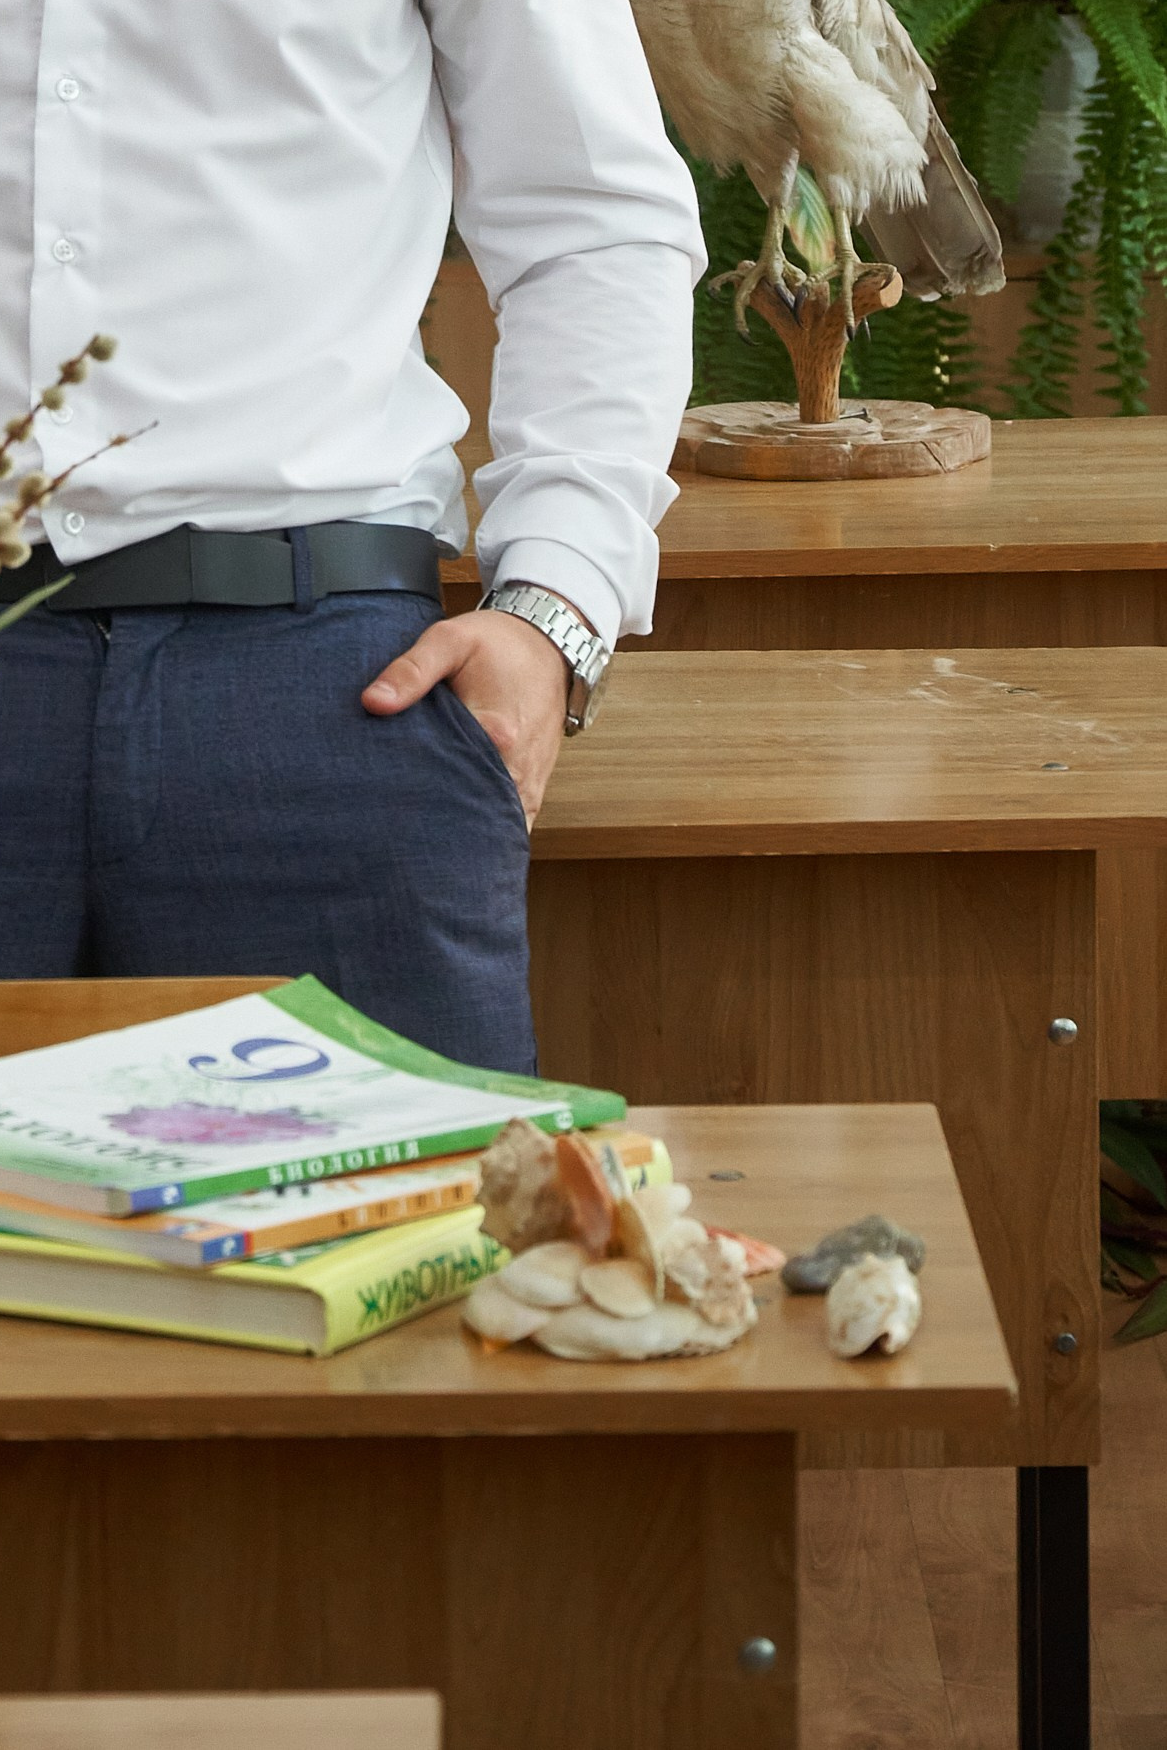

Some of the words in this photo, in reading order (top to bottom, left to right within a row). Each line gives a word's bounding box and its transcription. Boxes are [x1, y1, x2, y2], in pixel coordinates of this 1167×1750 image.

[188, 1037, 331, 1082] 9
[268, 1139, 420, 1186] БИОЛОГИЯ
[356, 1236, 503, 1332] ЖИВОТНЫЕ
